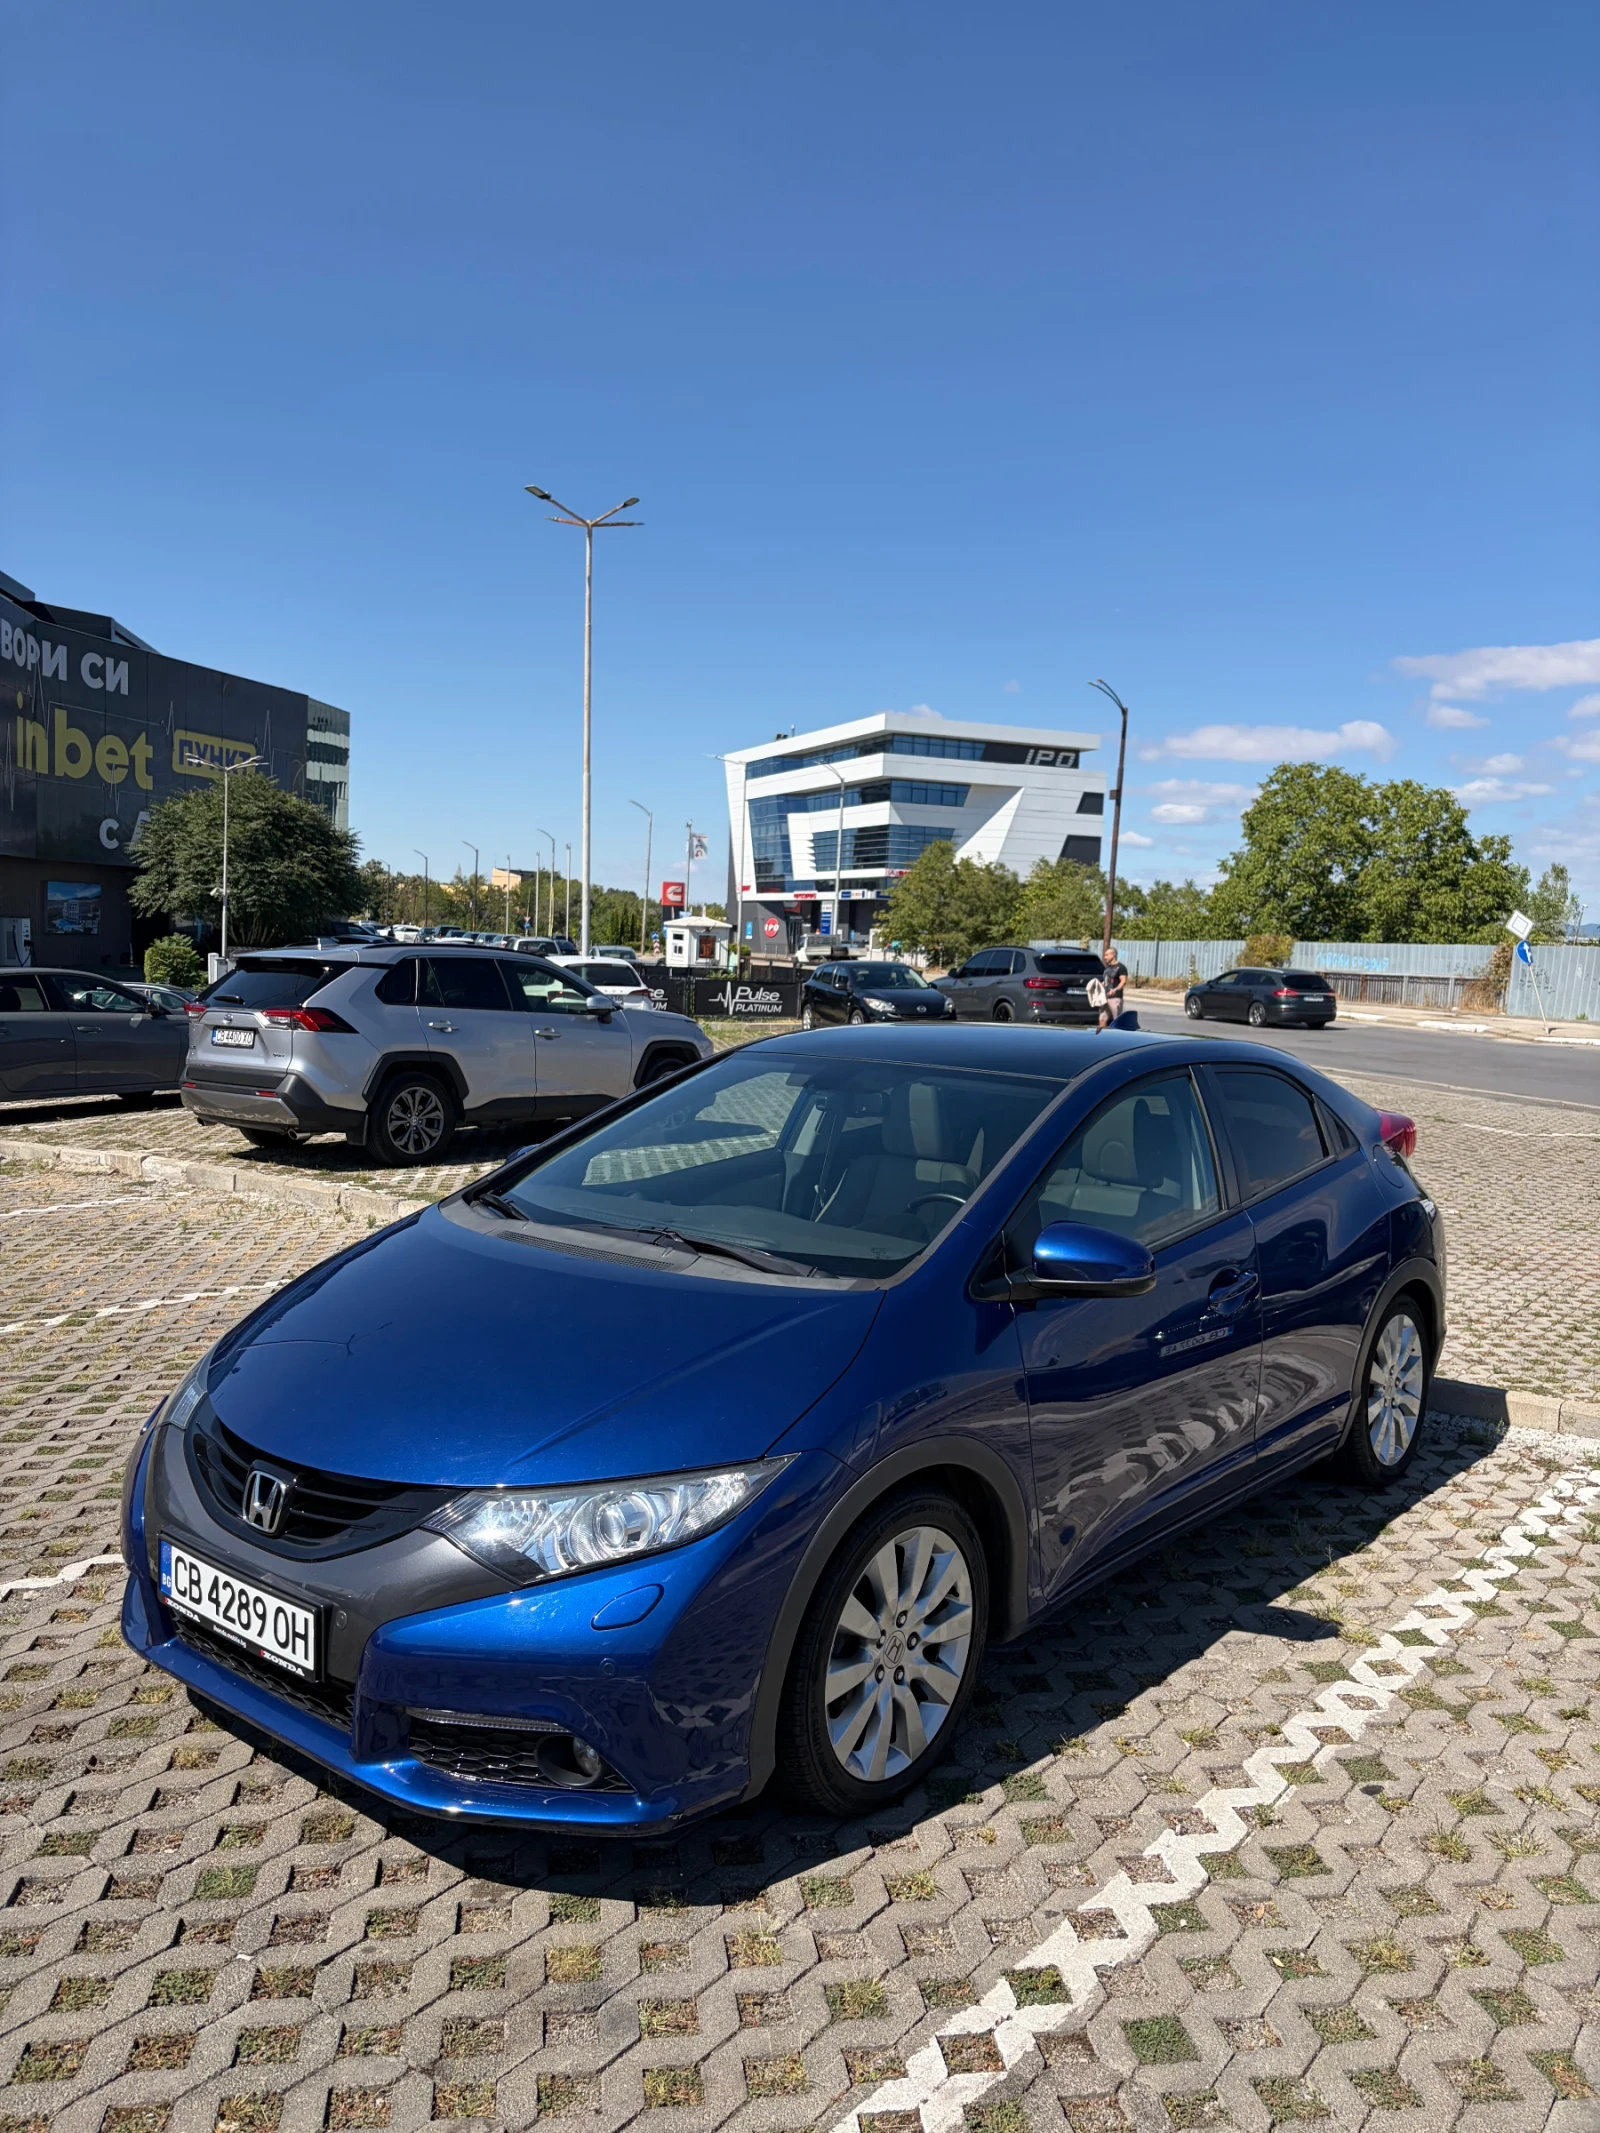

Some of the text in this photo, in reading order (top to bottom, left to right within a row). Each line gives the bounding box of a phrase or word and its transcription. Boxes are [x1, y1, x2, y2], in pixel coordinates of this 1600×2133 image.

[81, 652, 128, 695] СИ
[17, 691, 153, 790] inbet
[178, 739, 251, 776] ПУНКТ
[1024, 748, 1076, 768] IPO
[764, 923, 779, 931] IPO
[735, 986, 781, 1001] Pulse
[735, 1002, 783, 1013] PLATINUM
[162, 1573, 172, 1588] BG
[174, 1556, 309, 1661] CB 4289 OH
